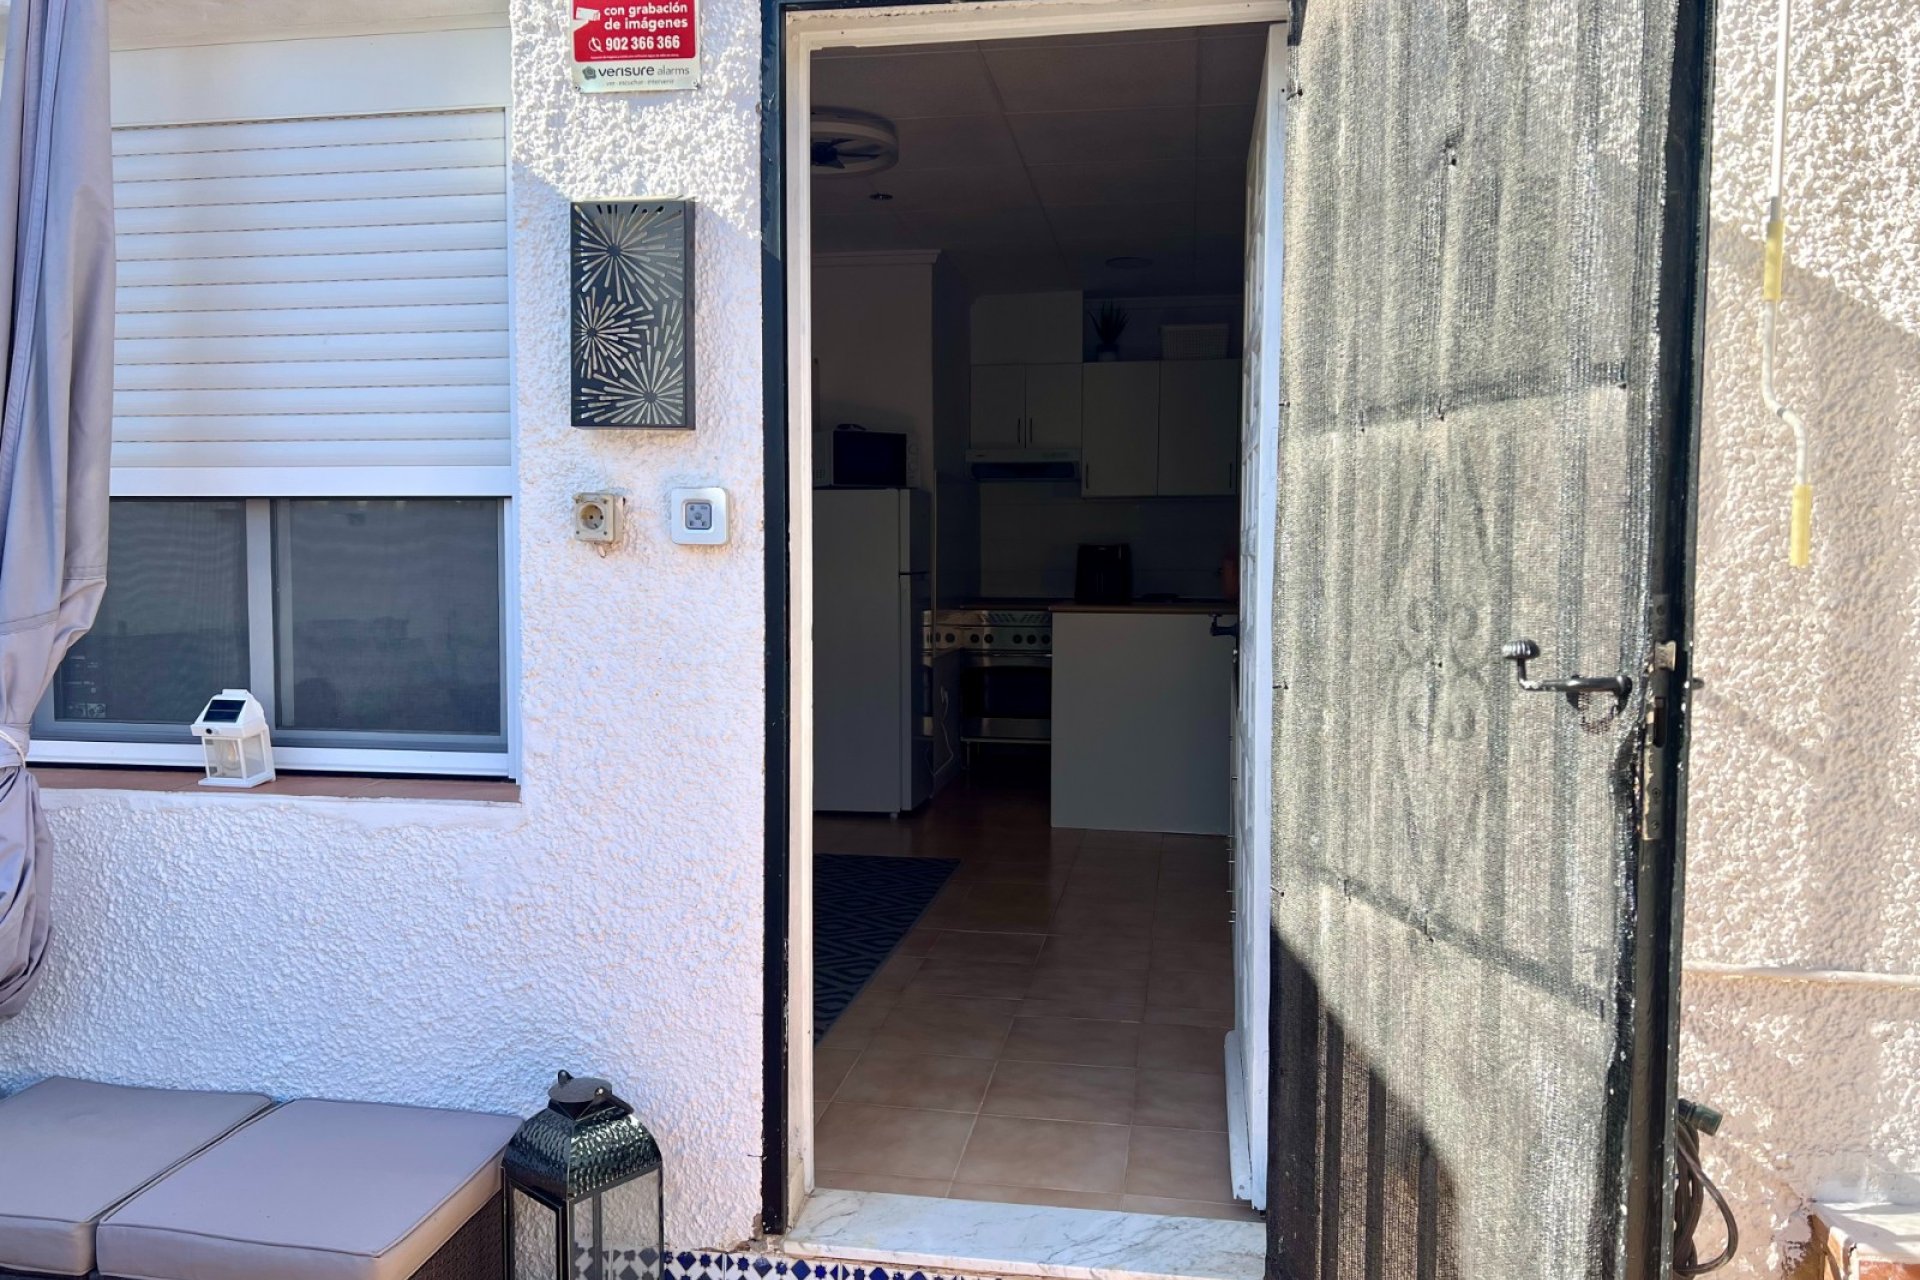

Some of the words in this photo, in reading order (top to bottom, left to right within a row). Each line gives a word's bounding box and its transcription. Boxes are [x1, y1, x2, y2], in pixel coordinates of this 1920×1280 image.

[604, 7, 625, 16] con
[628, 1, 688, 17] grabación
[604, 17, 621, 30] de
[624, 17, 688, 32] imágenes
[605, 36, 628, 51] 902
[631, 35, 654, 50] 366
[657, 35, 680, 49] 366
[598, 66, 655, 77] verisure
[657, 65, 690, 76] alarms
